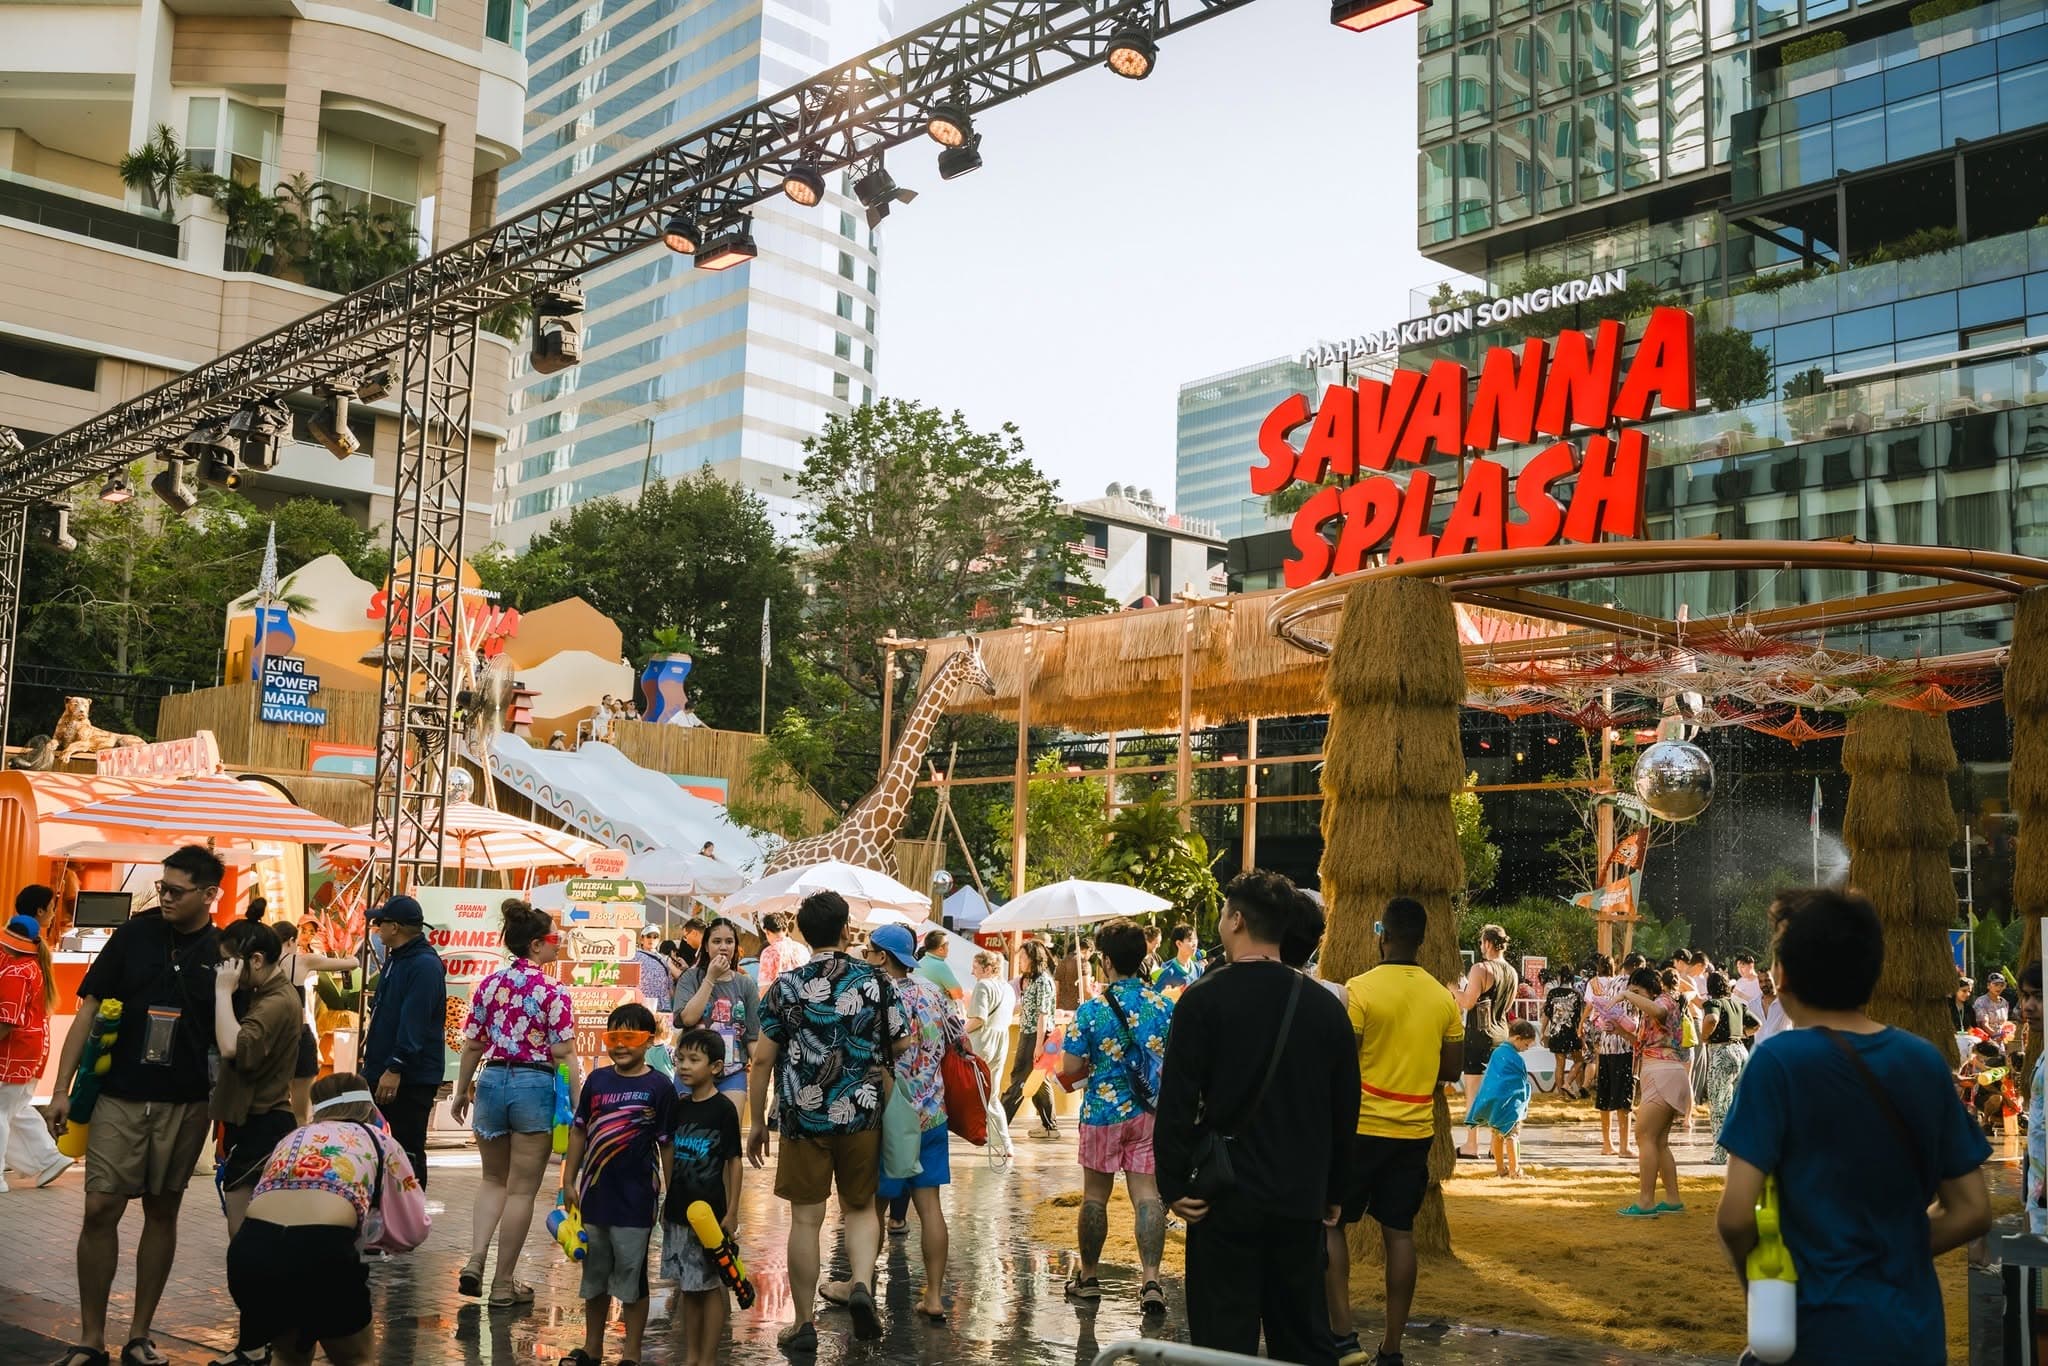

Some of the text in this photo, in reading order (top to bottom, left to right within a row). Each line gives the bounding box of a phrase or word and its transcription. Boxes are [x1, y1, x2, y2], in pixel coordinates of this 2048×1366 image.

[1305, 268, 1628, 369] MAHANAKHON SONGKRAN
[1250, 305, 1697, 495] SAVANNA
[1283, 429, 1650, 588] SPLASH
[458, 585, 501, 599] ONGKRAN
[267, 658, 304, 673] KING
[265, 674, 319, 692] POWER
[264, 691, 307, 706] MAHA
[263, 707, 325, 724] NAKHON
[592, 857, 624, 867] SAVANNA
[594, 864, 621, 873] SPLASH
[571, 881, 613, 891] WATERFALL
[571, 890, 598, 898] TOWER
[454, 904, 487, 912] SAVANNA
[580, 944, 616, 955] SLIDER
[599, 969, 620, 979] BAR
[578, 1016, 608, 1025] RESTRO
[602, 1093, 622, 1104] WALK
